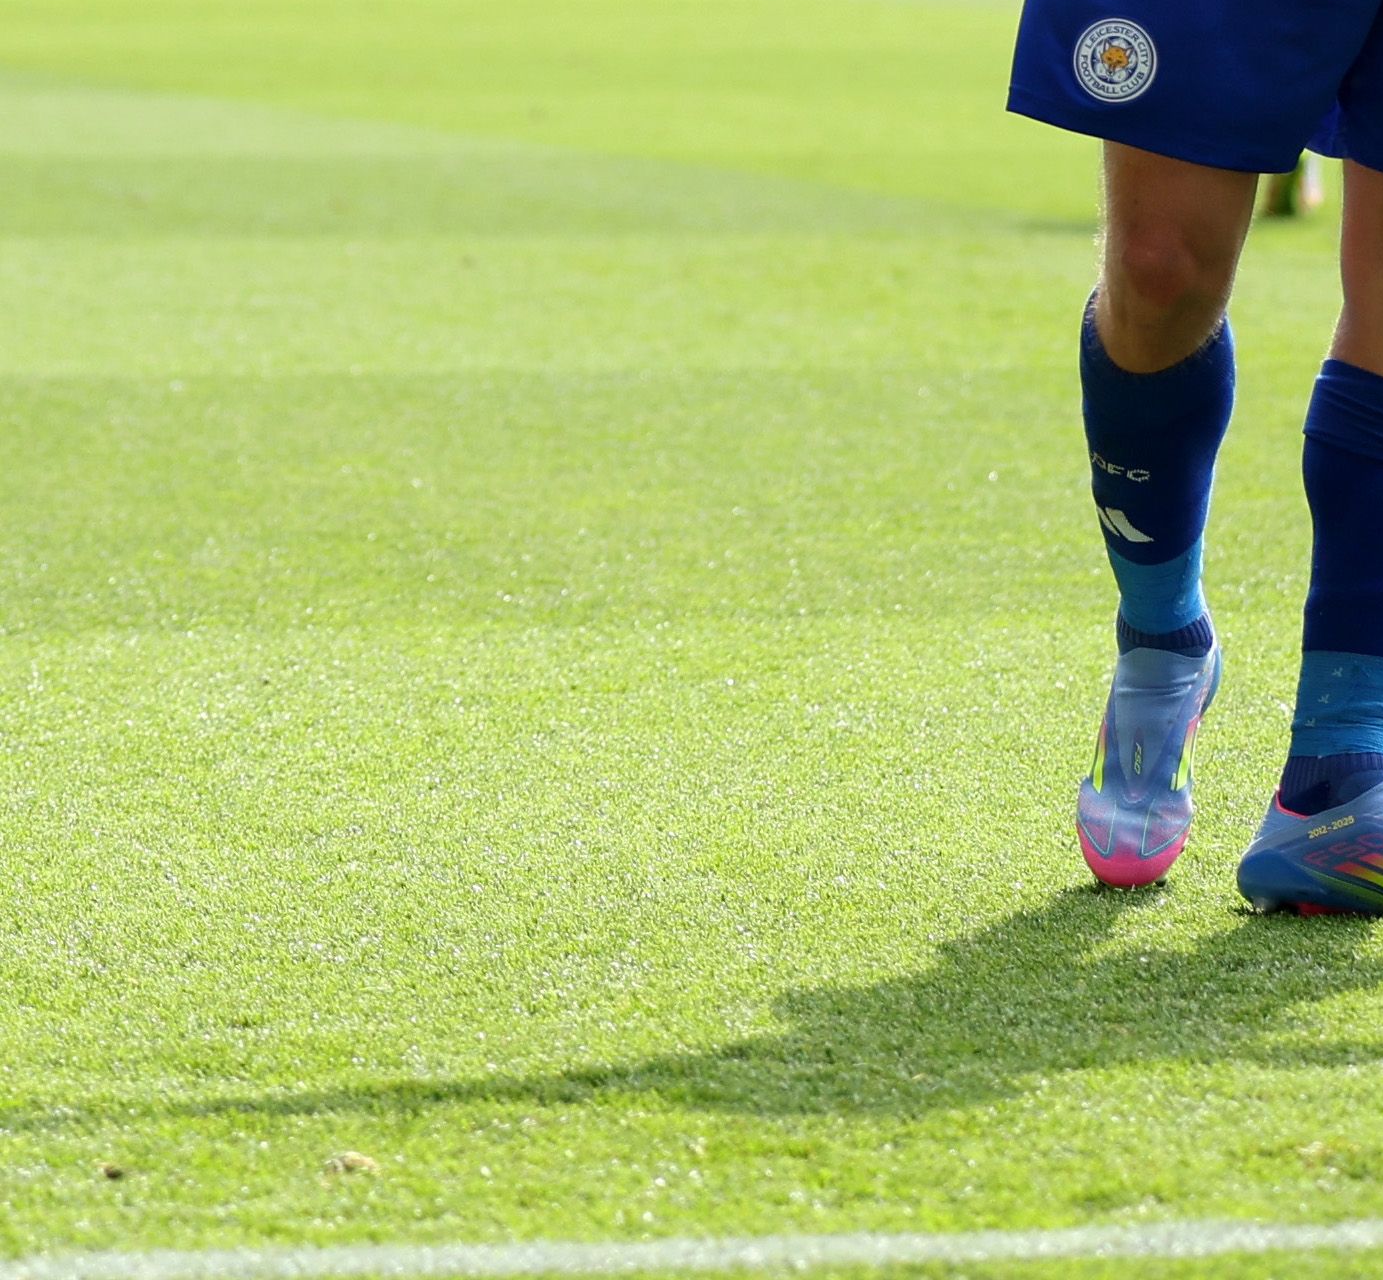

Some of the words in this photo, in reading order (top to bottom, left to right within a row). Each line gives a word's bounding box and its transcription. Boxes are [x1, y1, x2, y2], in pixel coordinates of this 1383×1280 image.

[1085, 26, 1139, 49] LEICESTER
[1137, 42, 1149, 67] CITY
[1081, 55, 1119, 94] FOOTBALL
[1120, 72, 1145, 94] CLUB
[1307, 815, 1355, 839] 2012-2025
